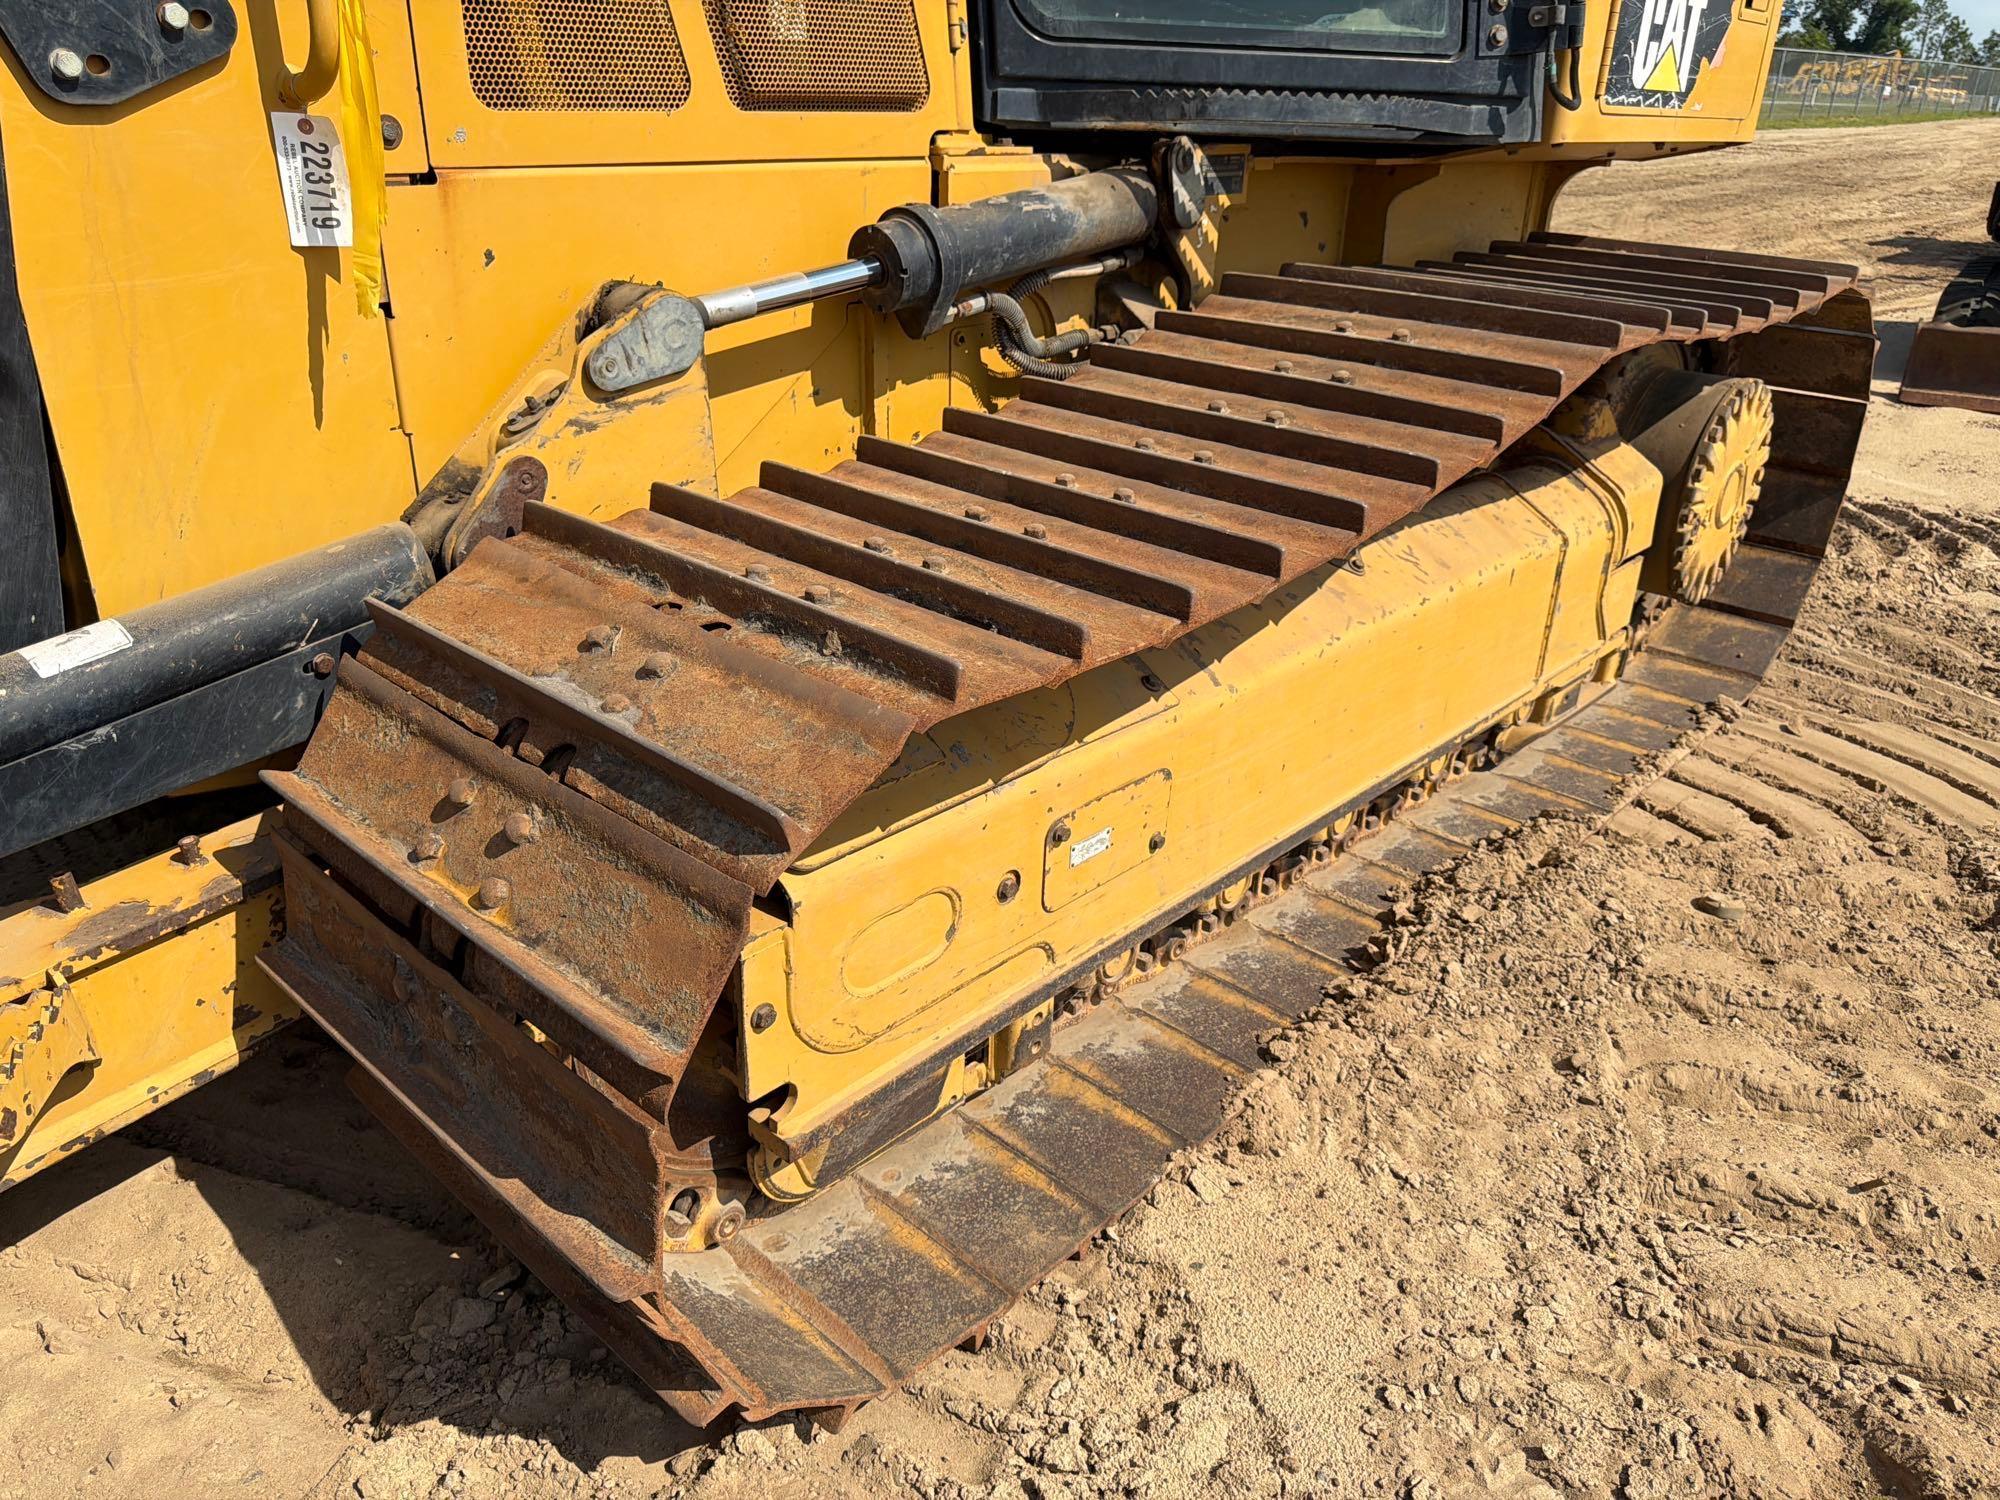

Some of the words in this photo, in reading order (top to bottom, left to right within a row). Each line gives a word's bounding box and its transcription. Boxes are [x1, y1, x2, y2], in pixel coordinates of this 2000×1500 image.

[1631, 0, 1708, 93] CAT
[290, 143, 298, 164] REBEL
[293, 165, 303, 195] AUCTION
[300, 141, 342, 229] 223719
[298, 195, 308, 227] COMPANY
